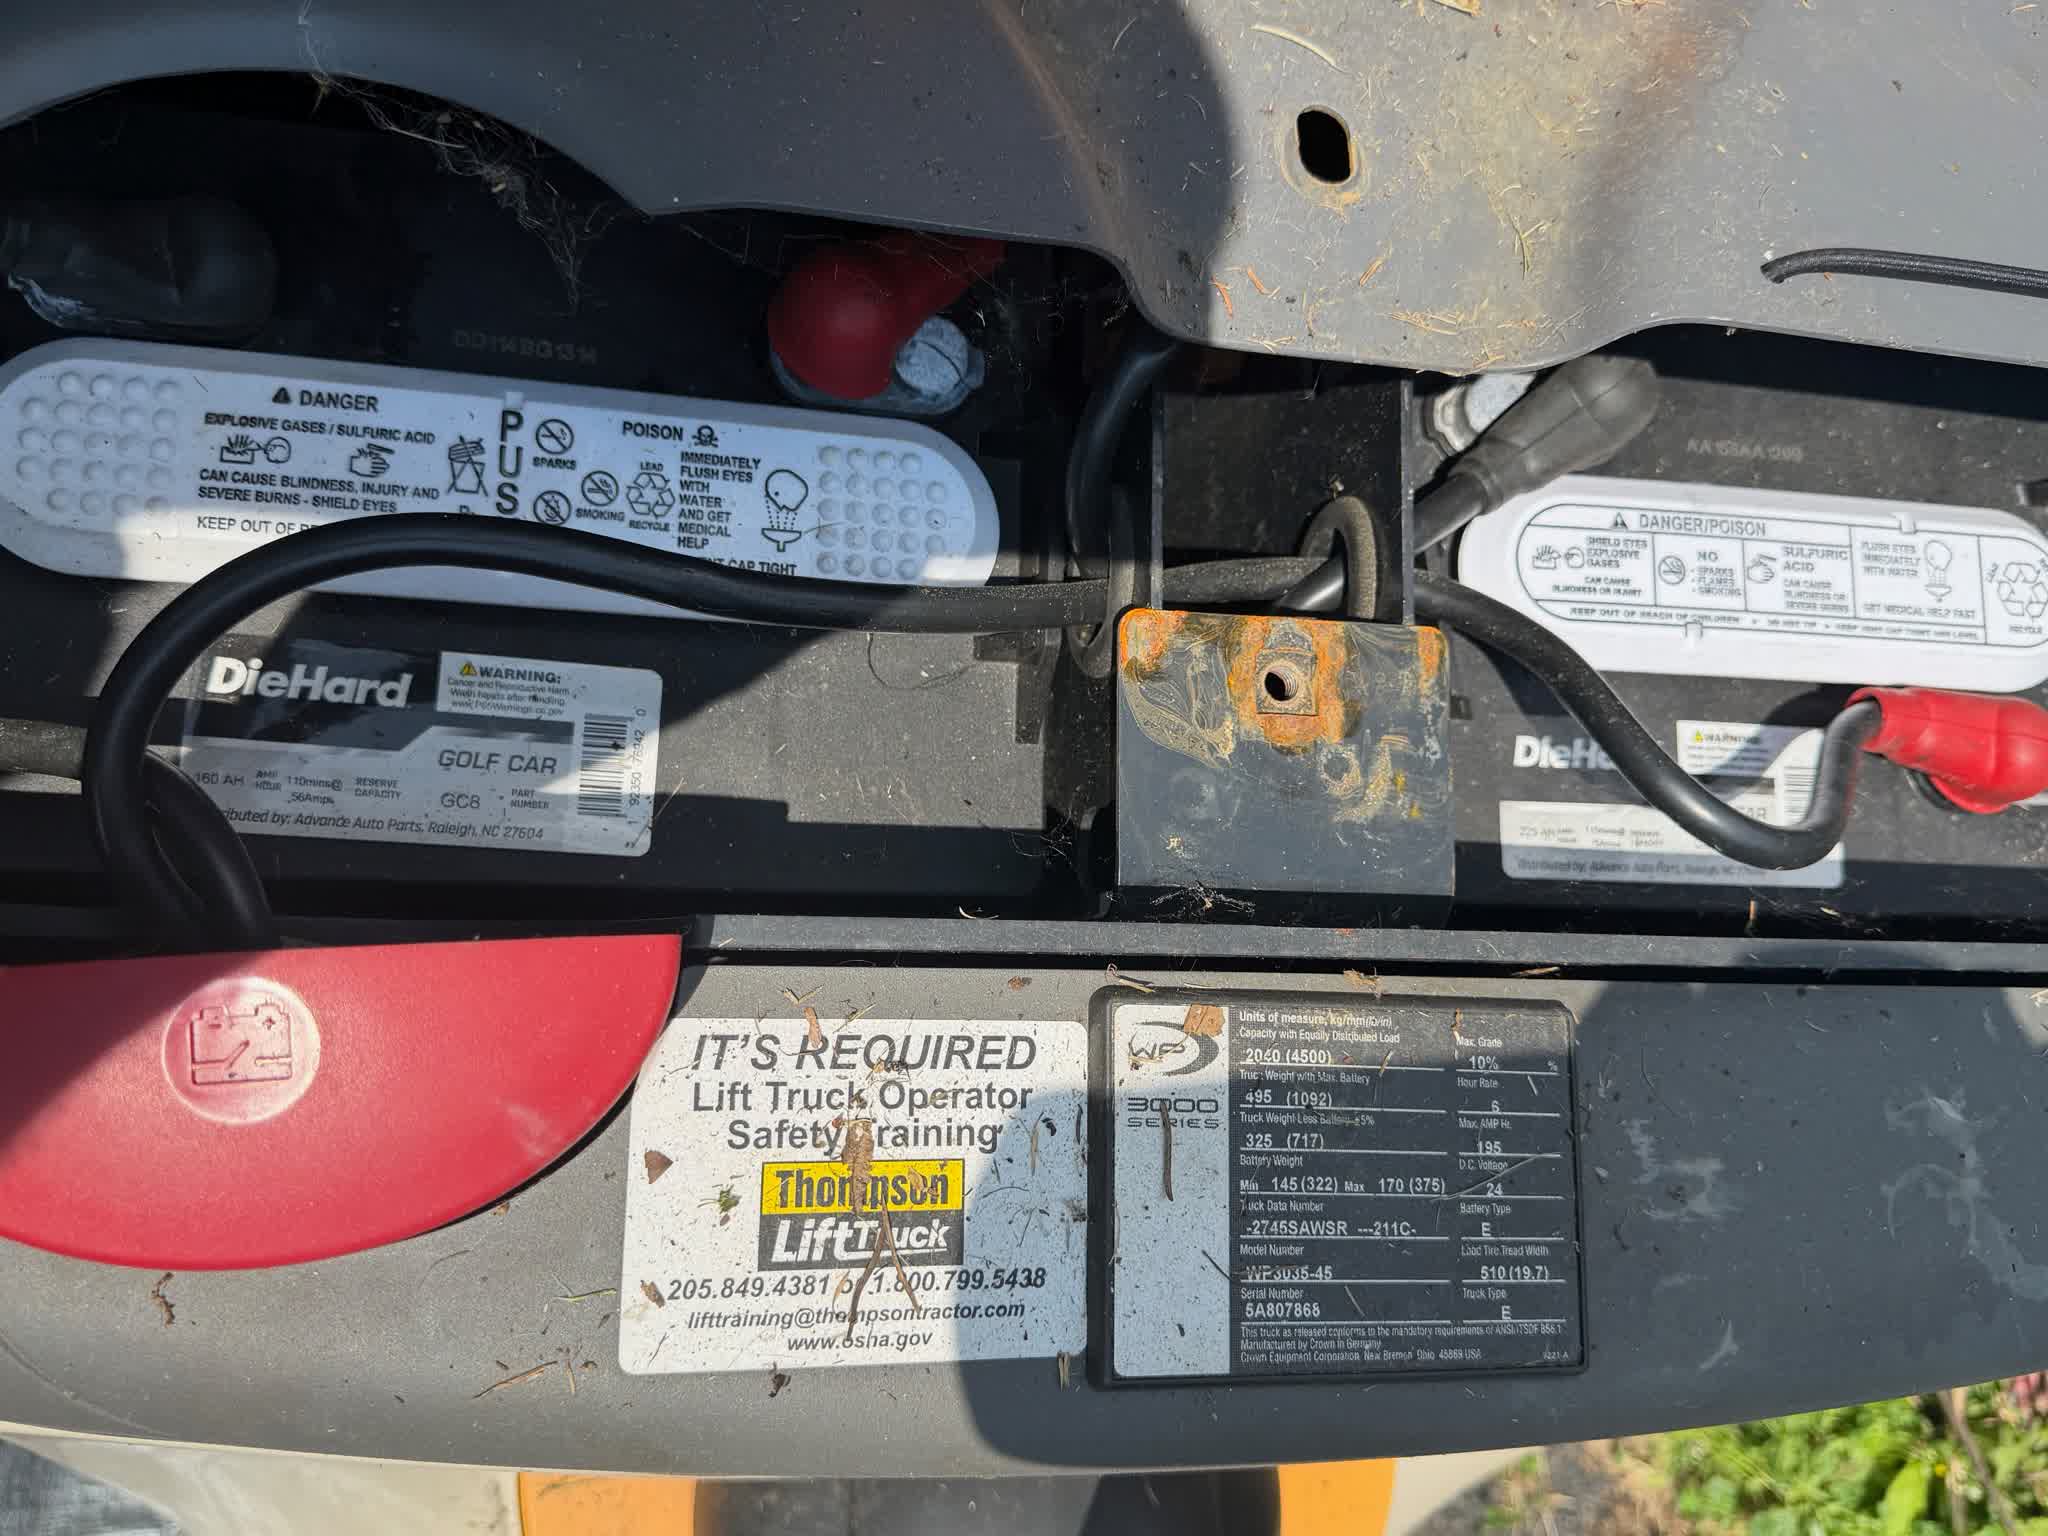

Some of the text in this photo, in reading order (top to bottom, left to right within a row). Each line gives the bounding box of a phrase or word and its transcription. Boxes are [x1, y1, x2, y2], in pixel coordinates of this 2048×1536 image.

[300, 390, 379, 412] DANGER
[204, 412, 436, 444] EXPLOSIVE GASES SULFURIC ACID
[622, 421, 684, 441] POISON
[532, 456, 577, 471] SPARKS
[640, 461, 664, 472] LEAD
[680, 451, 761, 470] IMMEDIATELY
[680, 465, 753, 483] FLUSH EYES
[199, 468, 440, 500] CAN CAUSE BLINDNESS, INJURY AND
[679, 479, 710, 494] WITH
[198, 486, 397, 513] SEVERE BURNS SHIELD EYES
[678, 494, 722, 508] WATER
[575, 507, 625, 522] SMOKING
[678, 508, 732, 523] AND GET
[197, 515, 236, 531] KEEP
[240, 519, 272, 533] OUT
[275, 521, 296, 535] OF
[629, 519, 671, 532] RECYCLE
[678, 522, 732, 537] MEDICAL
[1639, 513, 1766, 536] DANGER/POISON
[677, 536, 710, 549] HELP
[759, 561, 797, 576] TIGHT
[1783, 561, 1815, 573] ACID
[206, 656, 414, 708] DieHard
[479, 666, 561, 684] WARNING:
[1513, 735, 1617, 770] DieH
[438, 749, 557, 774] GOLF CAR
[223, 774, 245, 785] AH
[255, 781, 282, 791] HOUR
[355, 776, 400, 789] RESERVE
[354, 787, 402, 800] CAPACITY
[440, 792, 481, 809] GC8
[511, 788, 536, 798] PART
[510, 799, 549, 809] NUMBER
[271, 811, 291, 826] by:
[294, 813, 350, 828] Advance
[352, 816, 384, 830] Auto
[482, 824, 501, 837] NC
[504, 826, 544, 839] 27604
[1239, 1011, 1266, 1022] Units
[1268, 1012, 1279, 1024] of
[1239, 1026, 1400, 1044] Capacity with Equally Distributed Load
[1478, 1037, 1503, 1048] Grade
[691, 1034, 1037, 1070] IT'S REQUIRED
[1245, 1048, 1332, 1065] 2040 (4500)
[1469, 1055, 1499, 1070] 10%
[1265, 1070, 1295, 1083] Weight
[1339, 1072, 1371, 1085] Battery
[1457, 1077, 1499, 1089] Hour Rate
[693, 1080, 1033, 1116] Lift Truck Operator
[1245, 1088, 1333, 1106] 495 (1092)
[1127, 1097, 1219, 1113] 3000
[1127, 1117, 1220, 1129] SERIES
[1239, 1111, 1264, 1124] Truck
[1265, 1112, 1295, 1126] Weight
[1297, 1113, 1318, 1125] Less
[1480, 1117, 1500, 1129] AMP
[727, 1118, 999, 1156] Safety raining
[1245, 1132, 1324, 1149] 325 (717)
[1478, 1141, 1501, 1154] 195
[1239, 1154, 1304, 1168] Battery Weight
[775, 1168, 950, 1209] Thompson
[1239, 1176, 1445, 1194] Min 145 (322) Max 170 (375)
[1486, 1182, 1503, 1196] 24
[1267, 1200, 1324, 1212] Data Number
[1460, 1202, 1511, 1216] Battery Type
[1481, 1222, 1491, 1237] E
[1239, 1244, 1305, 1256] Model Number
[1524, 1244, 1550, 1256] Width
[1480, 1265, 1550, 1280] 510 (19.7)
[667, 1267, 1047, 1300] 205.849.4381 1.800.799.5438
[1240, 1287, 1304, 1300] Serial Number
[1463, 1287, 1507, 1300] Truck Type
[688, 1303, 1026, 1330] lifttraining@thompsontractor.com
[1501, 1305, 1512, 1320] E
[1240, 1326, 1258, 1337] This
[1260, 1326, 1281, 1337] truck
[788, 1331, 934, 1352] www.osha.gov
[1309, 1338, 1336, 1349] Crown
